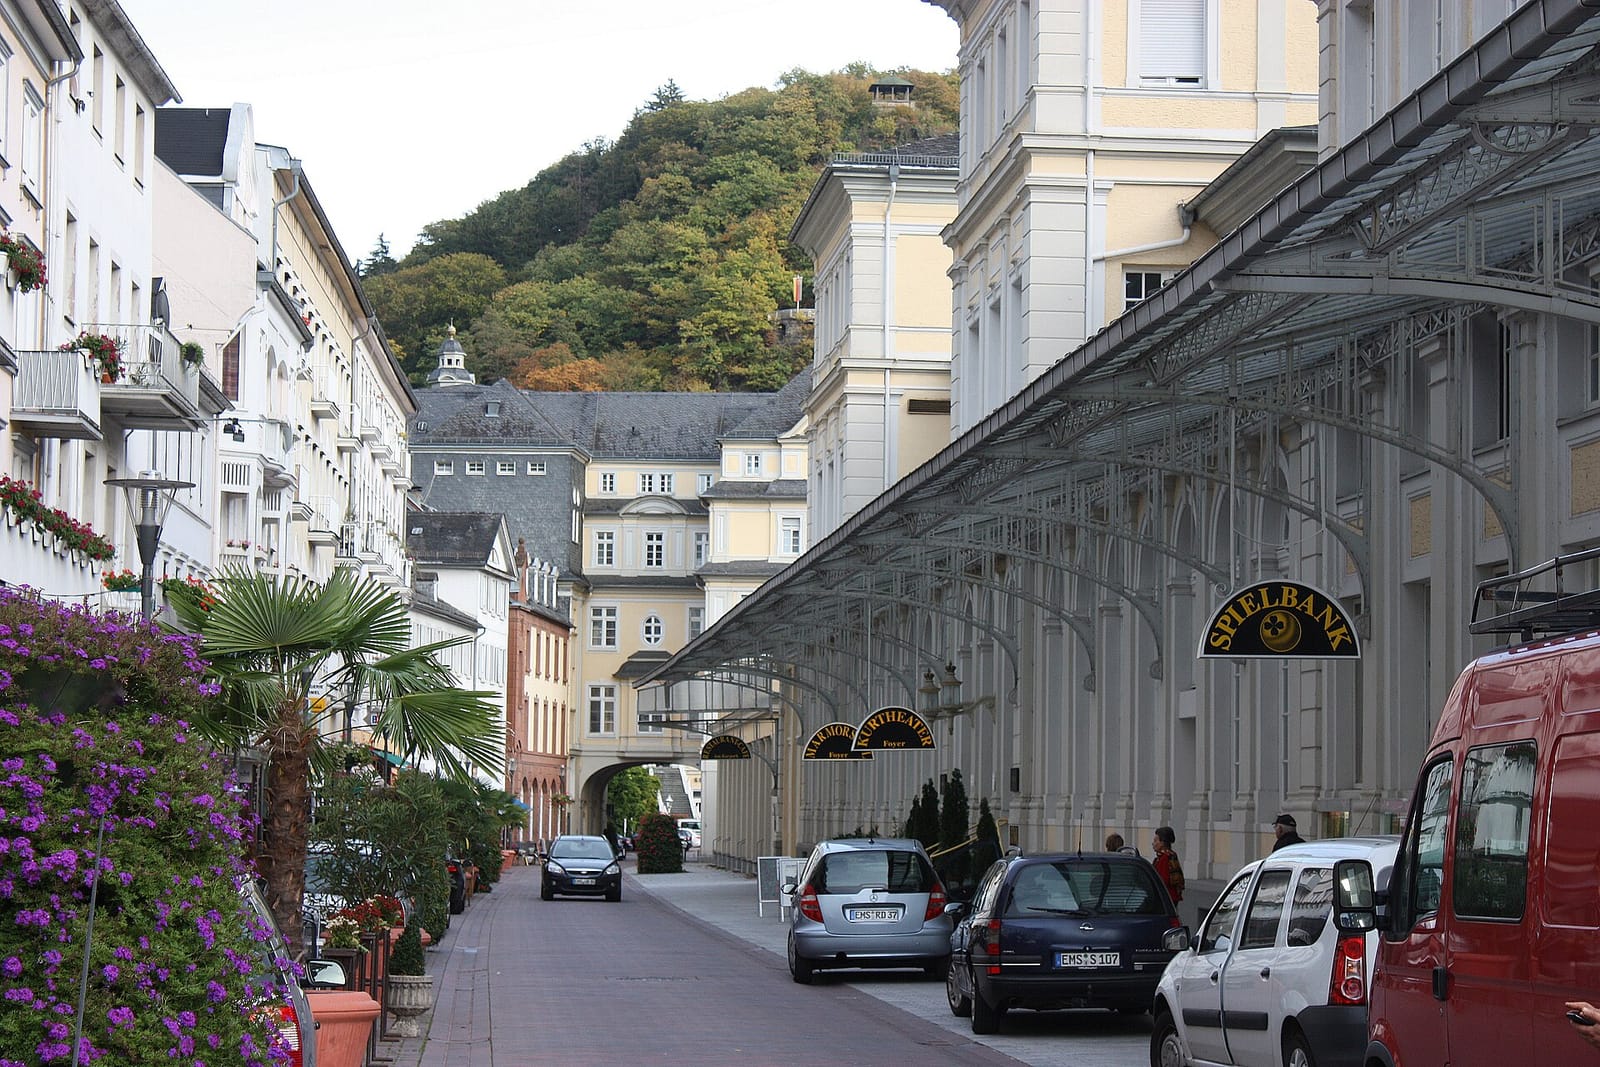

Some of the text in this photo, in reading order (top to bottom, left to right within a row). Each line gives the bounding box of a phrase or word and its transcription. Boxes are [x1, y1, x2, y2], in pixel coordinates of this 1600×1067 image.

[1210, 586, 1353, 651] SPIELBANK
[857, 711, 932, 747] KURTHEATER
[806, 725, 872, 759] MARMORSL
[883, 740, 906, 748] Foyer
[829, 751, 848, 759] Foyer
[855, 911, 871, 919] EMS
[888, 911, 897, 919] 37
[1061, 954, 1119, 965] EMS S 107
